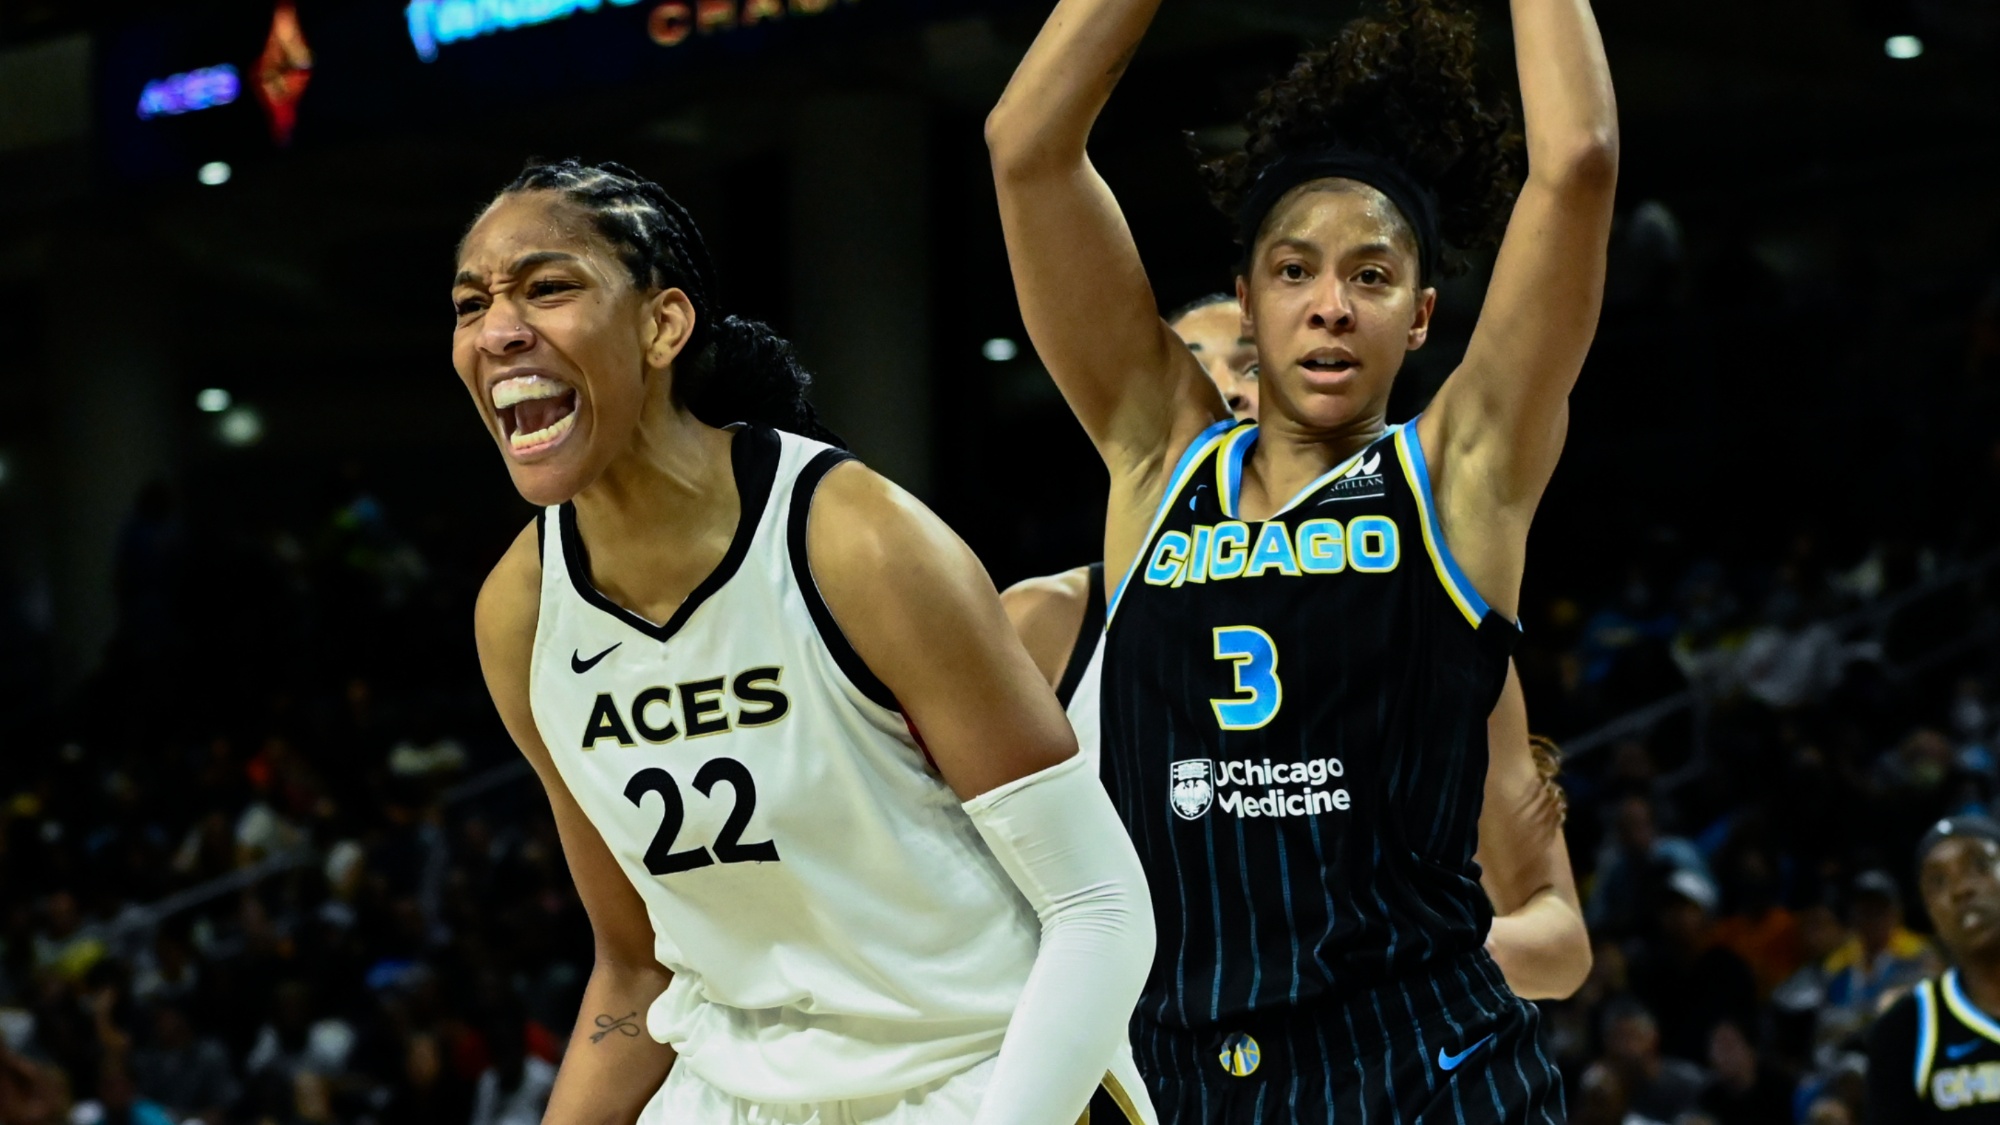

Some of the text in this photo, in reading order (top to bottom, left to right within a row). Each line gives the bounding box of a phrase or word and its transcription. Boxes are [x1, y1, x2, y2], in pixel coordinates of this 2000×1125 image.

[1331, 477, 1383, 492] GELLAN
[1144, 515, 1399, 588] CICAGO
[581, 665, 791, 751] ACES
[1210, 625, 1282, 730] 3
[1214, 757, 1344, 787] UChicago
[1217, 787, 1351, 818] Medicine
[623, 757, 780, 876] 22
